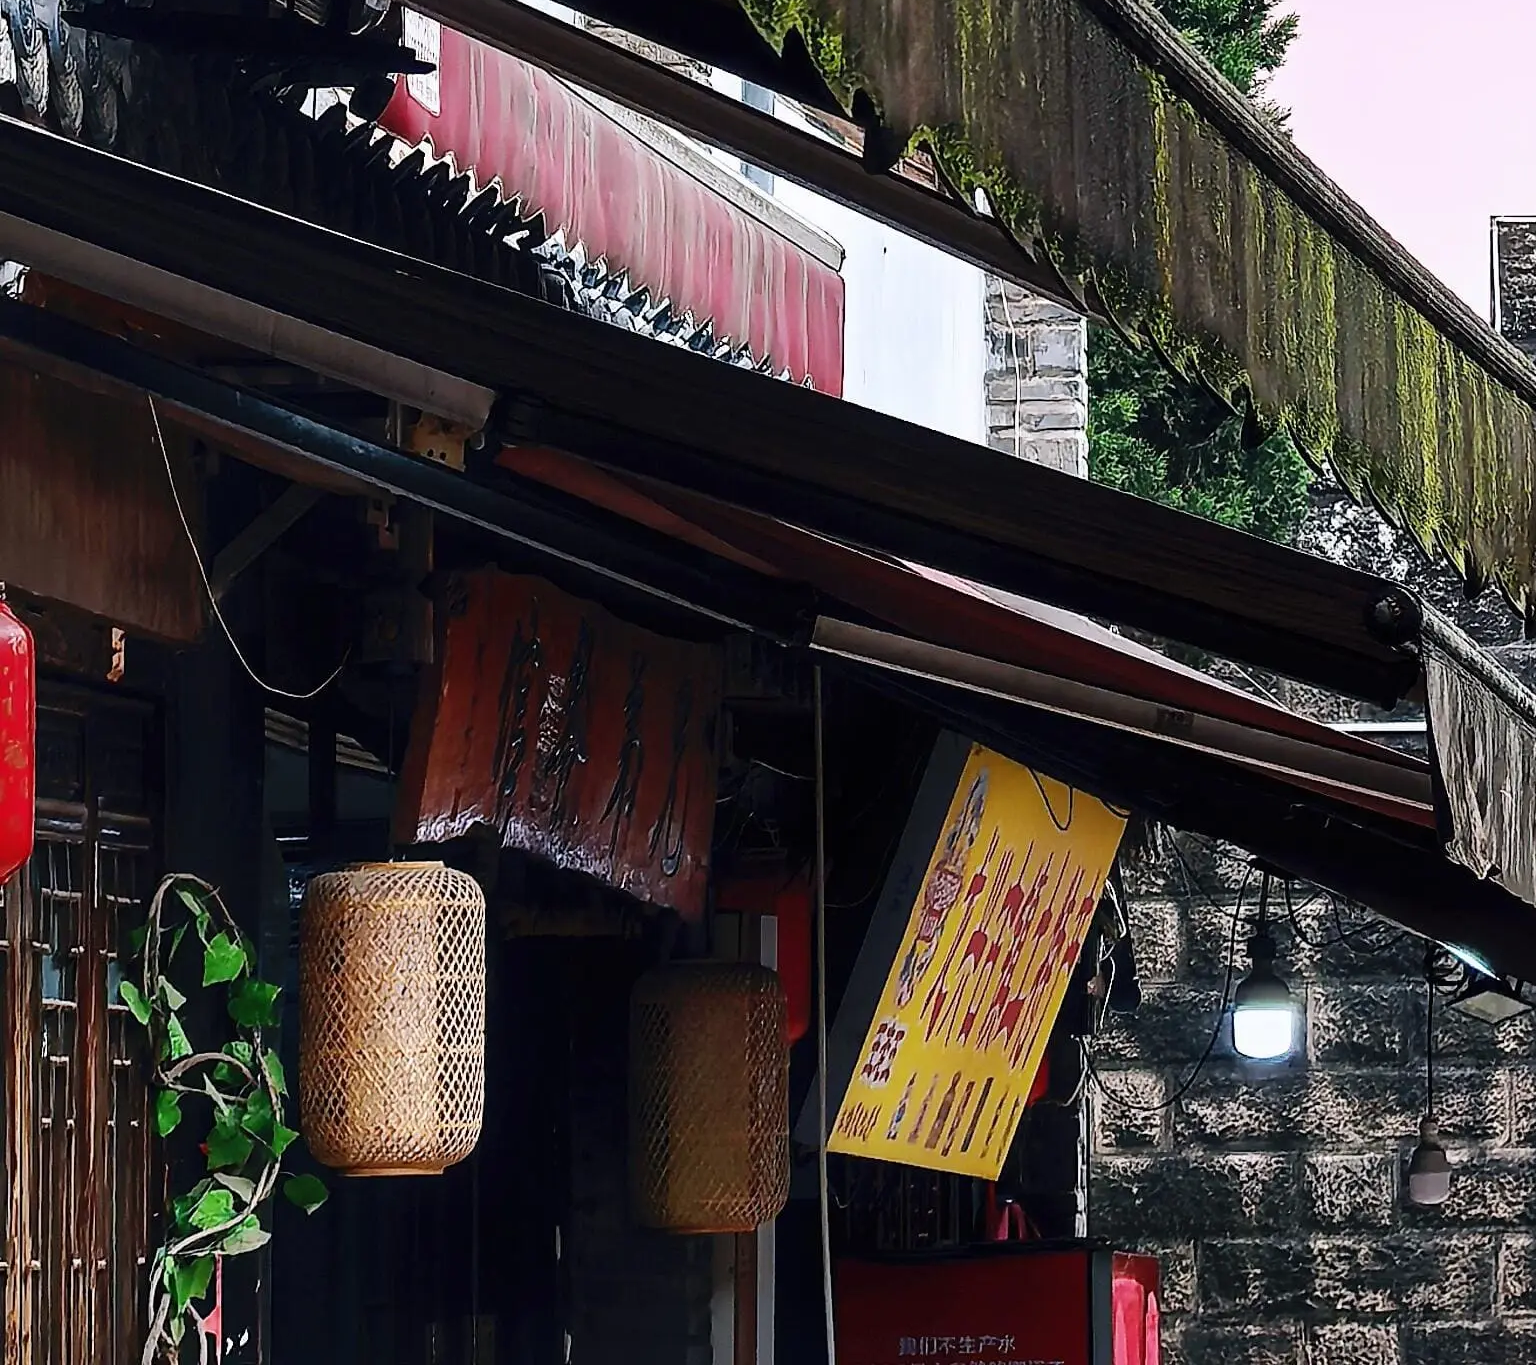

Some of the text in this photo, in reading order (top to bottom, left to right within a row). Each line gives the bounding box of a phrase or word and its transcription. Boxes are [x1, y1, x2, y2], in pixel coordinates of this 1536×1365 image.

[898, 1334, 1017, 1356] 我们不生产水
